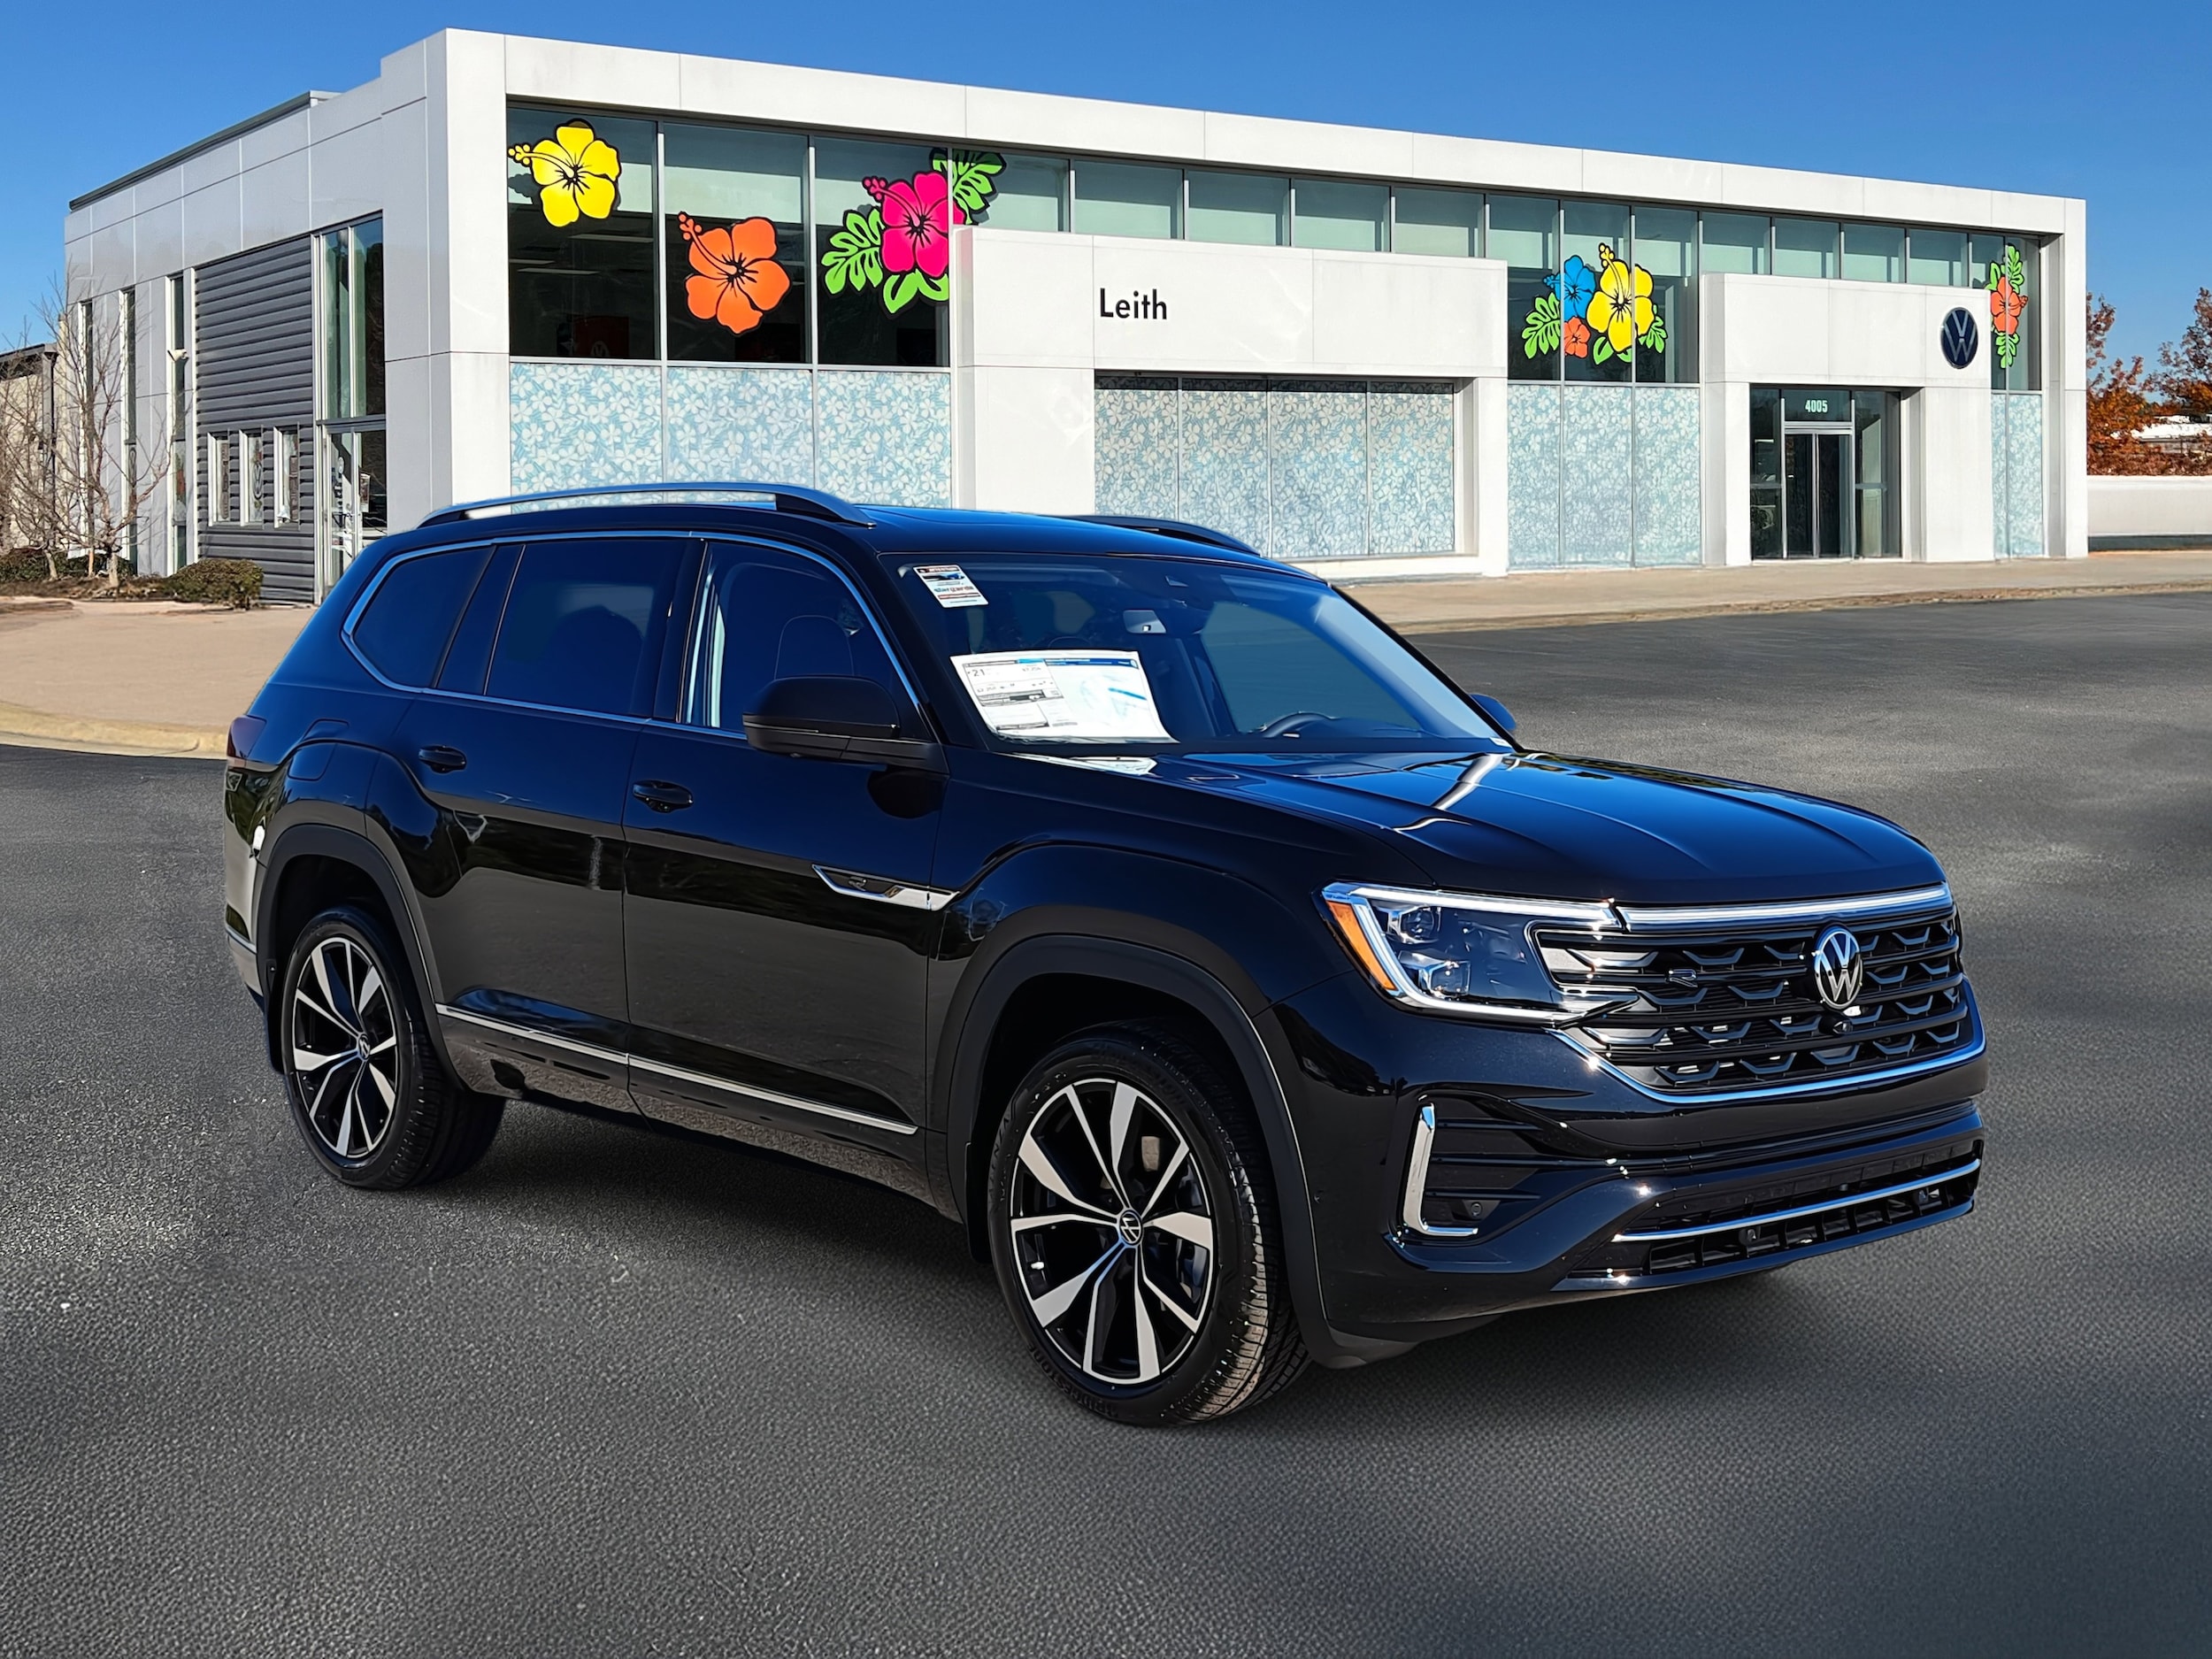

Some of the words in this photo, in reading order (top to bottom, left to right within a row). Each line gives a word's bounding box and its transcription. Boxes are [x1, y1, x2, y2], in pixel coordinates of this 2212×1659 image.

[1100, 288, 1167, 319] Leith
[1805, 400, 1828, 413] 4005
[1816, 928, 1862, 1007] VW
